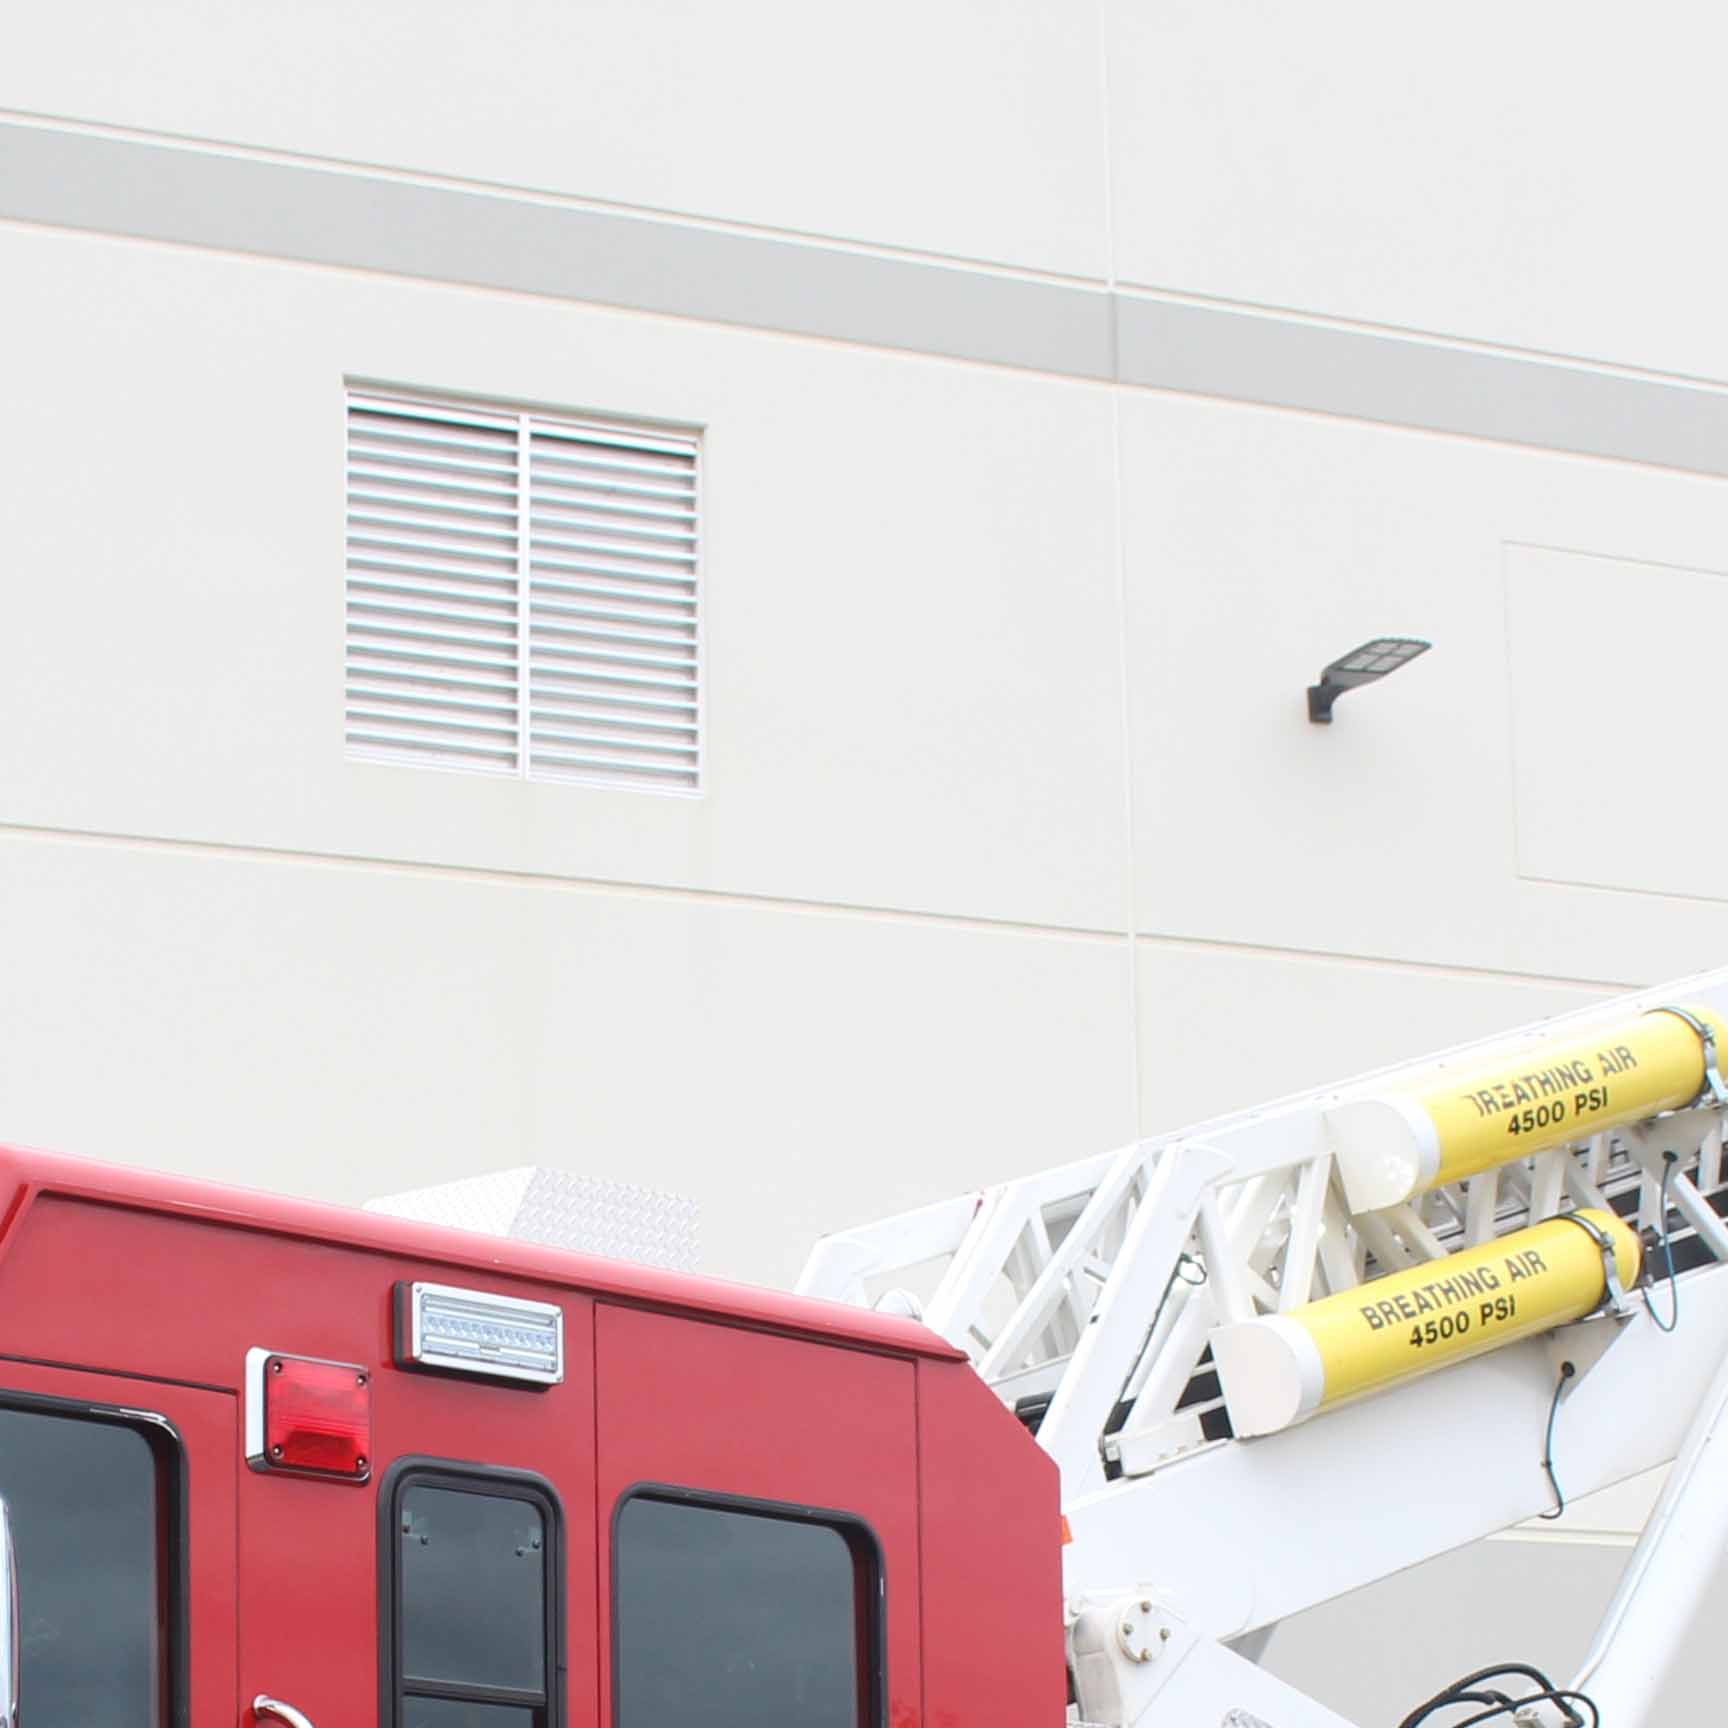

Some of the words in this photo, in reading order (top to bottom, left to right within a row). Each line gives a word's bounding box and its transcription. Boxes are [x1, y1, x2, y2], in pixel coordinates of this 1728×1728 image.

[1597, 1046, 1638, 1077] AIR
[1508, 1100, 1565, 1135] 4500
[1574, 1086, 1608, 1116] PSI
[1360, 1266, 1500, 1330] BREATHING
[1504, 1250, 1547, 1283] AIR
[1409, 1311, 1470, 1347] 4500
[1480, 1295, 1515, 1326] PSI
